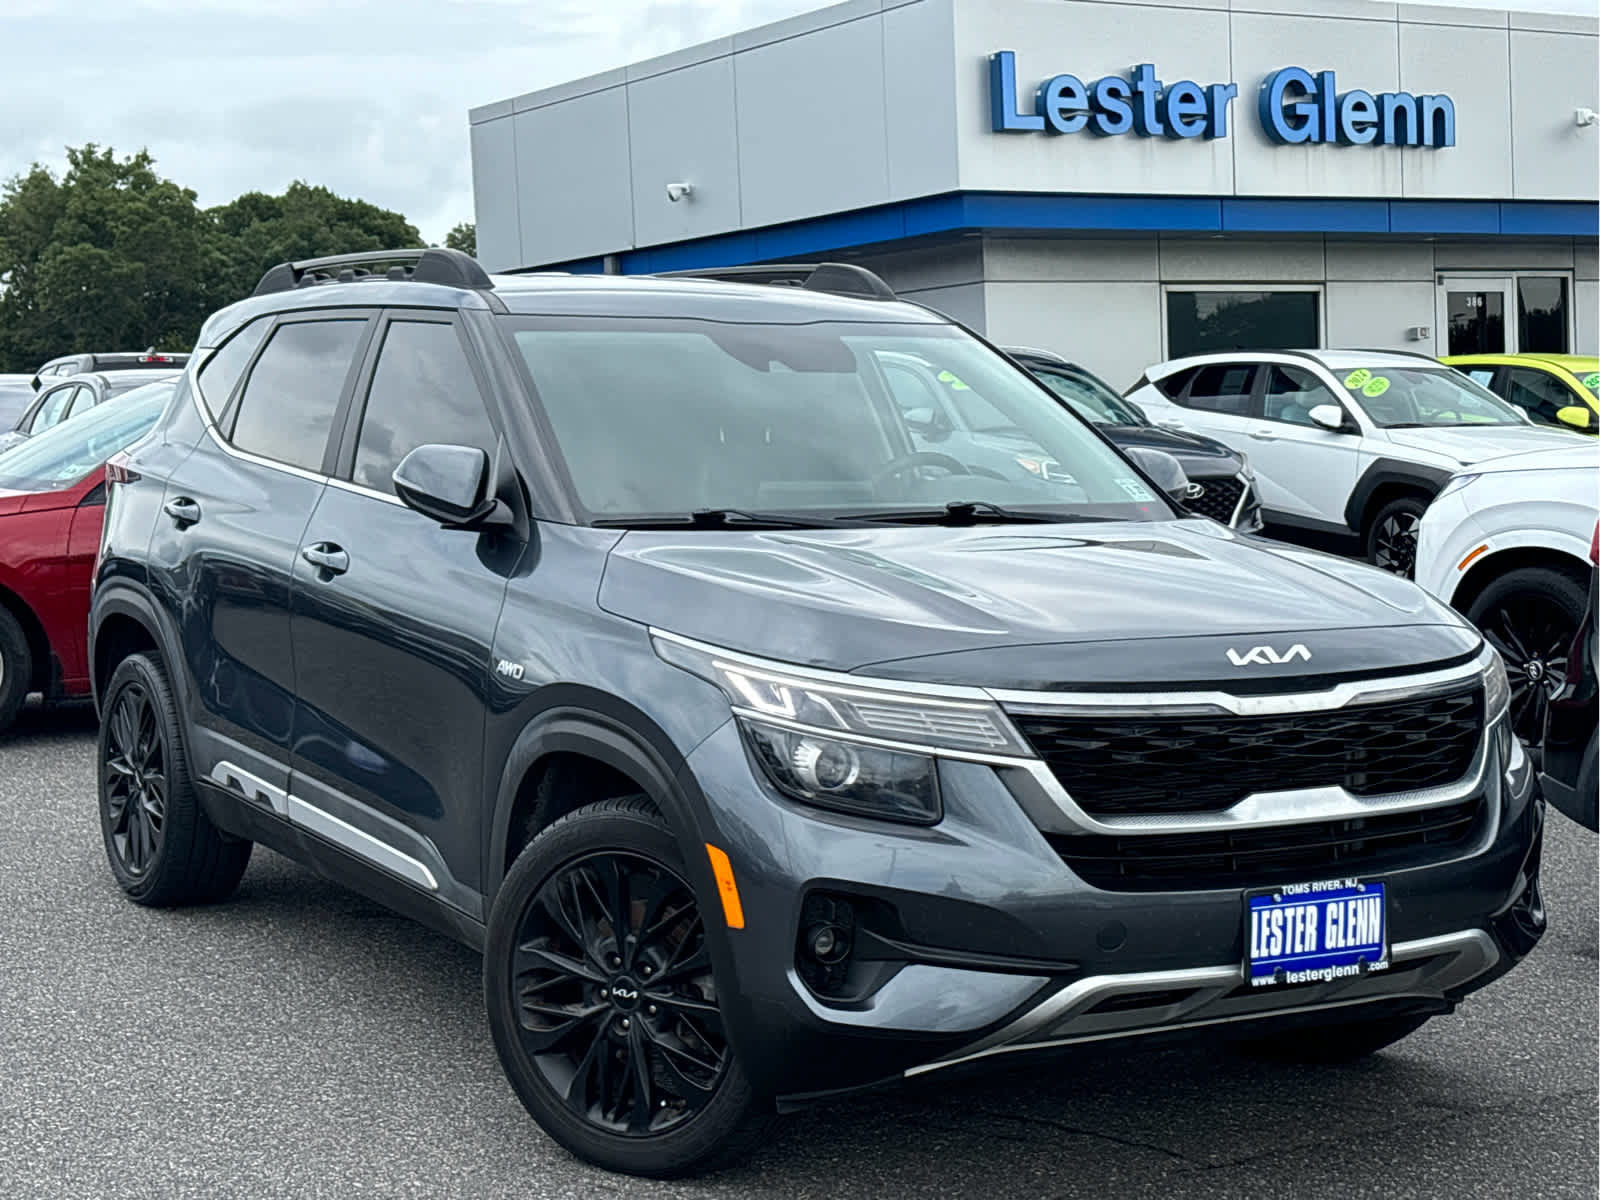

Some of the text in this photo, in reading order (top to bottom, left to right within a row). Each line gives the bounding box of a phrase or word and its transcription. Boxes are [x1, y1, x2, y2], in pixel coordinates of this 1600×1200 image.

[990, 50, 1456, 148] Lester Glenn
[1466, 296, 1483, 307] 386
[1225, 644, 1312, 666] KIA
[496, 659, 524, 680] AWD
[1281, 883, 1310, 896] TOMS
[1345, 877, 1358, 889] NJ
[1250, 897, 1381, 958] LESTER GLENN
